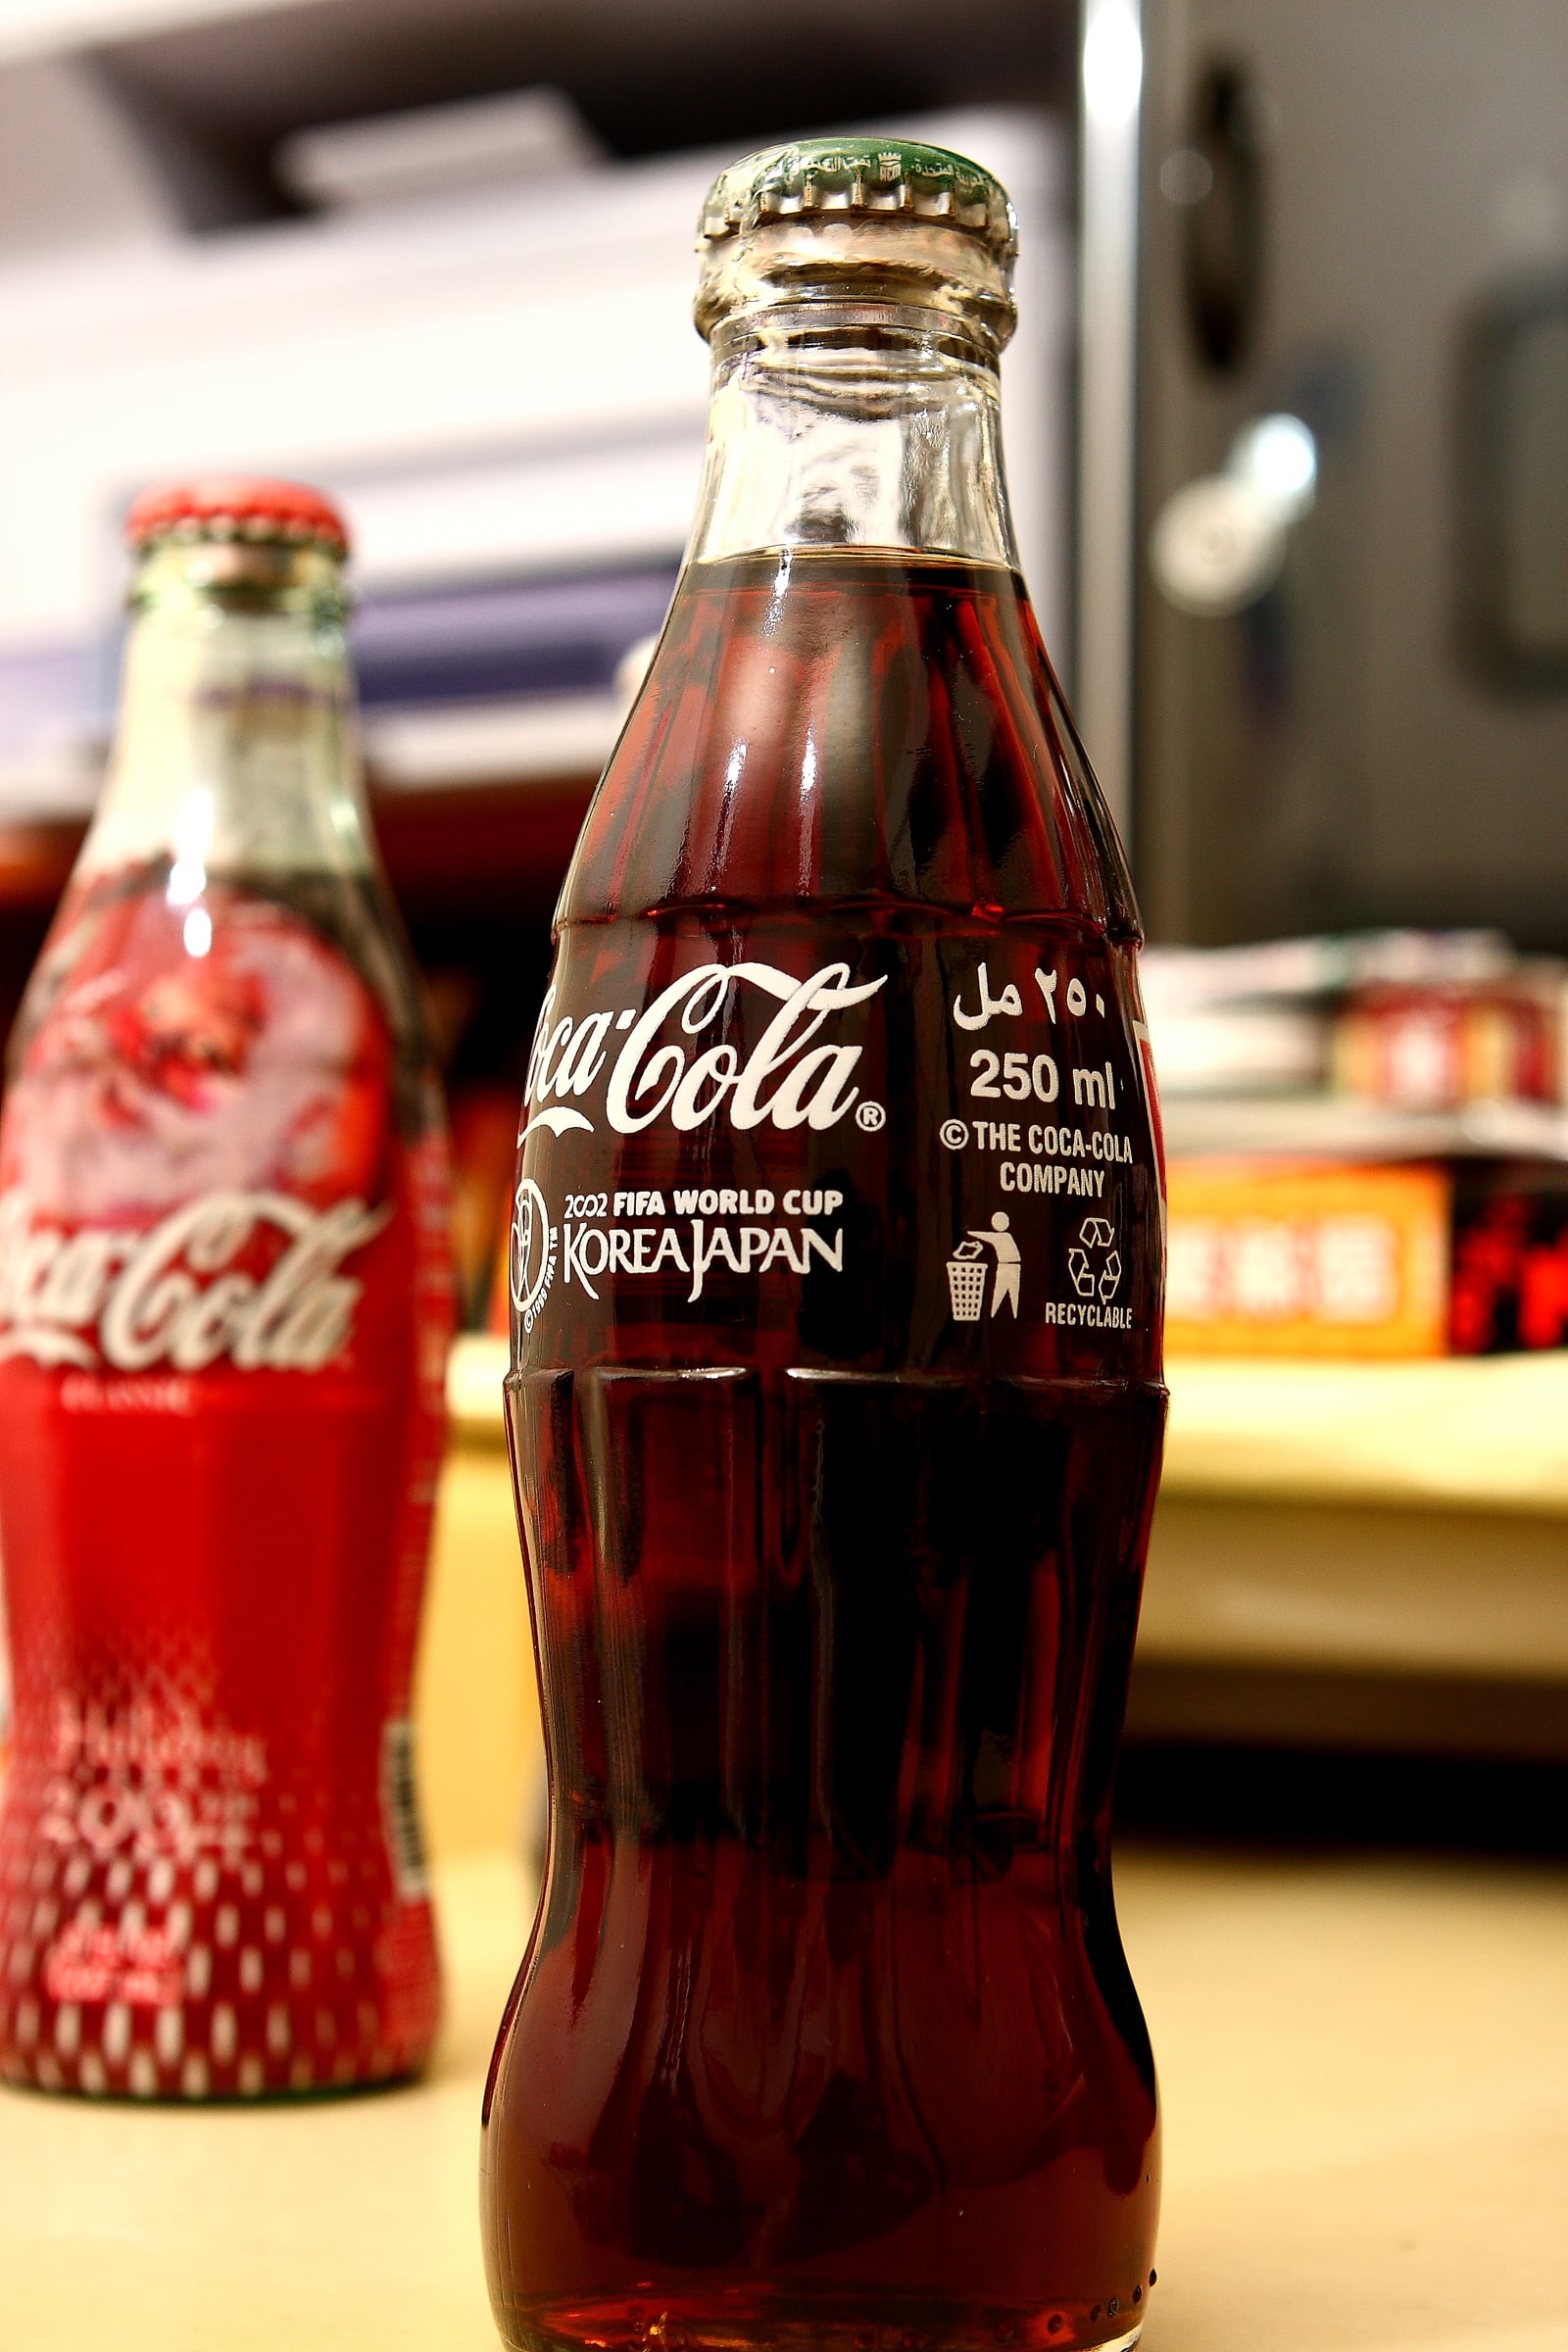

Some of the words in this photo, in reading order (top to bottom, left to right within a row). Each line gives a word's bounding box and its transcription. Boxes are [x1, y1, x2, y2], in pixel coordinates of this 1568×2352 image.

[953, 961, 1023, 1031] مل
[969, 1049, 1059, 1103] 250
[1072, 1061, 1116, 1110] ml
[972, 1120, 1022, 1152] THE
[1028, 1124, 1134, 1164] COCA-COLA
[1000, 1161, 1105, 1199] COMPANY
[564, 1192, 609, 1219] 2002
[612, 1191, 666, 1217] FIFA
[672, 1189, 775, 1215] WORLD
[782, 1189, 844, 1216] CUP
[563, 1221, 691, 1300] KOREA
[687, 1218, 844, 1303] JAPAN
[1045, 1301, 1133, 1330] RECYCLABLE
